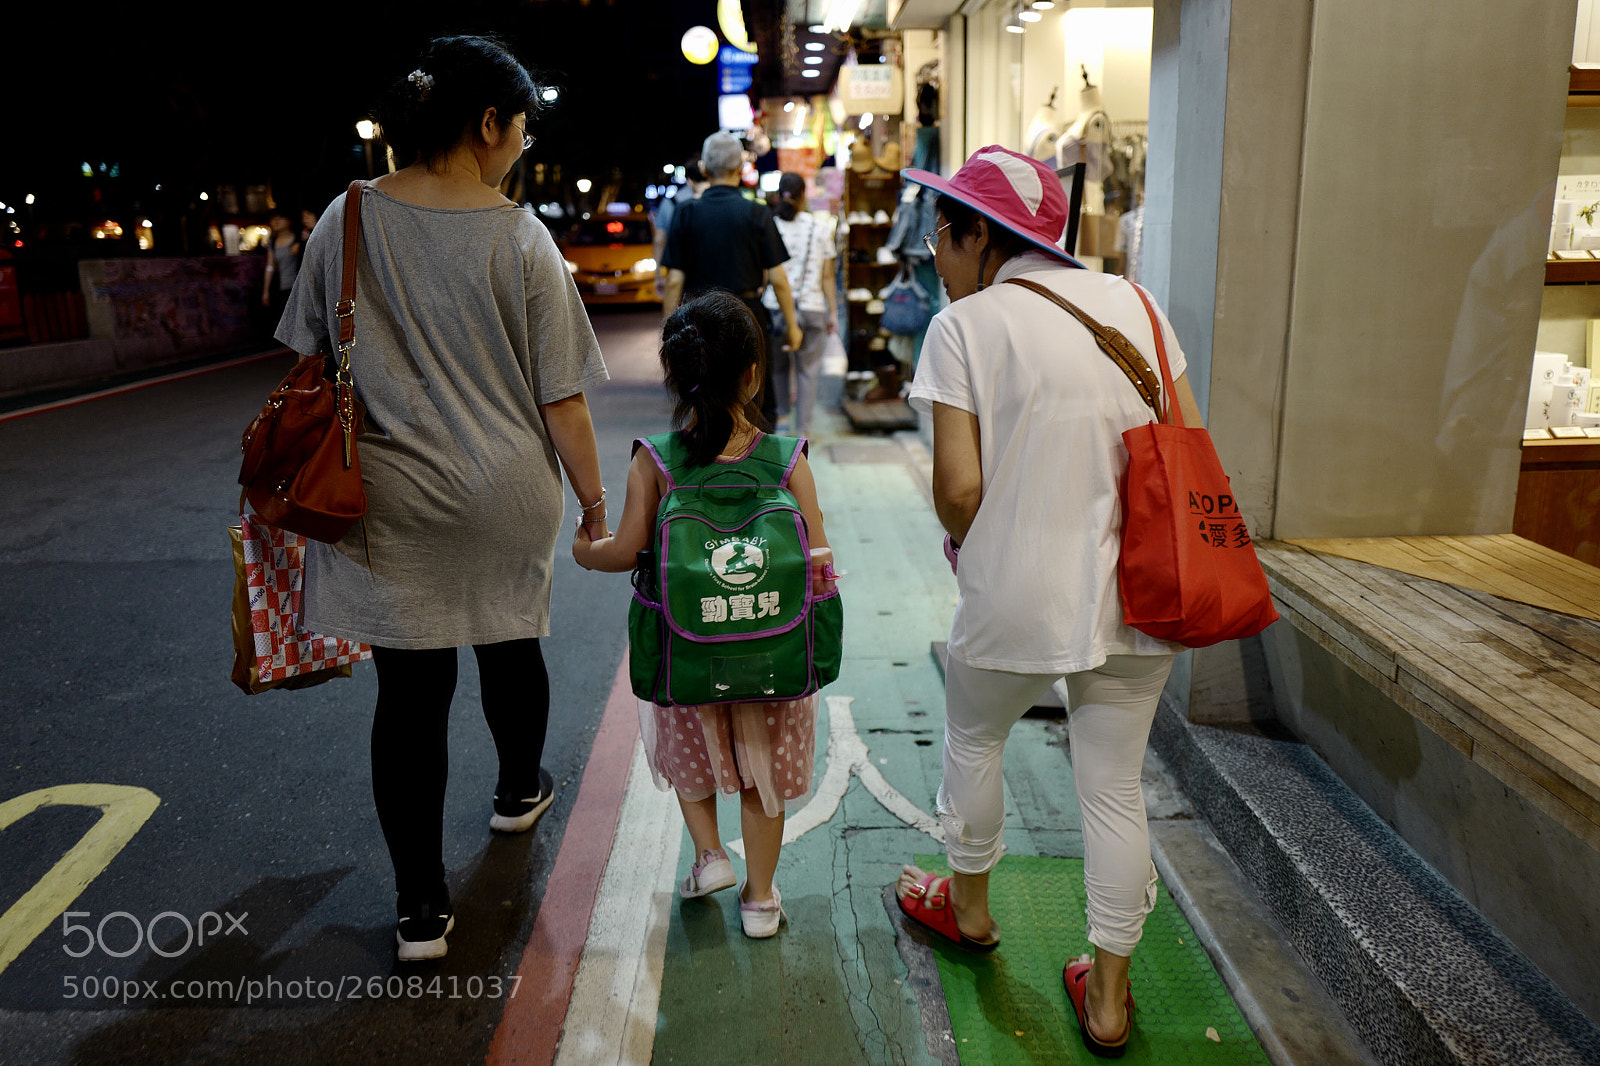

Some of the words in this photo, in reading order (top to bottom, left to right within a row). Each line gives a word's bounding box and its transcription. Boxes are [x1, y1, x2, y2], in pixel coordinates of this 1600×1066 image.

[704, 536, 768, 550] GYMBABY
[701, 591, 780, 623] 勁寶兒
